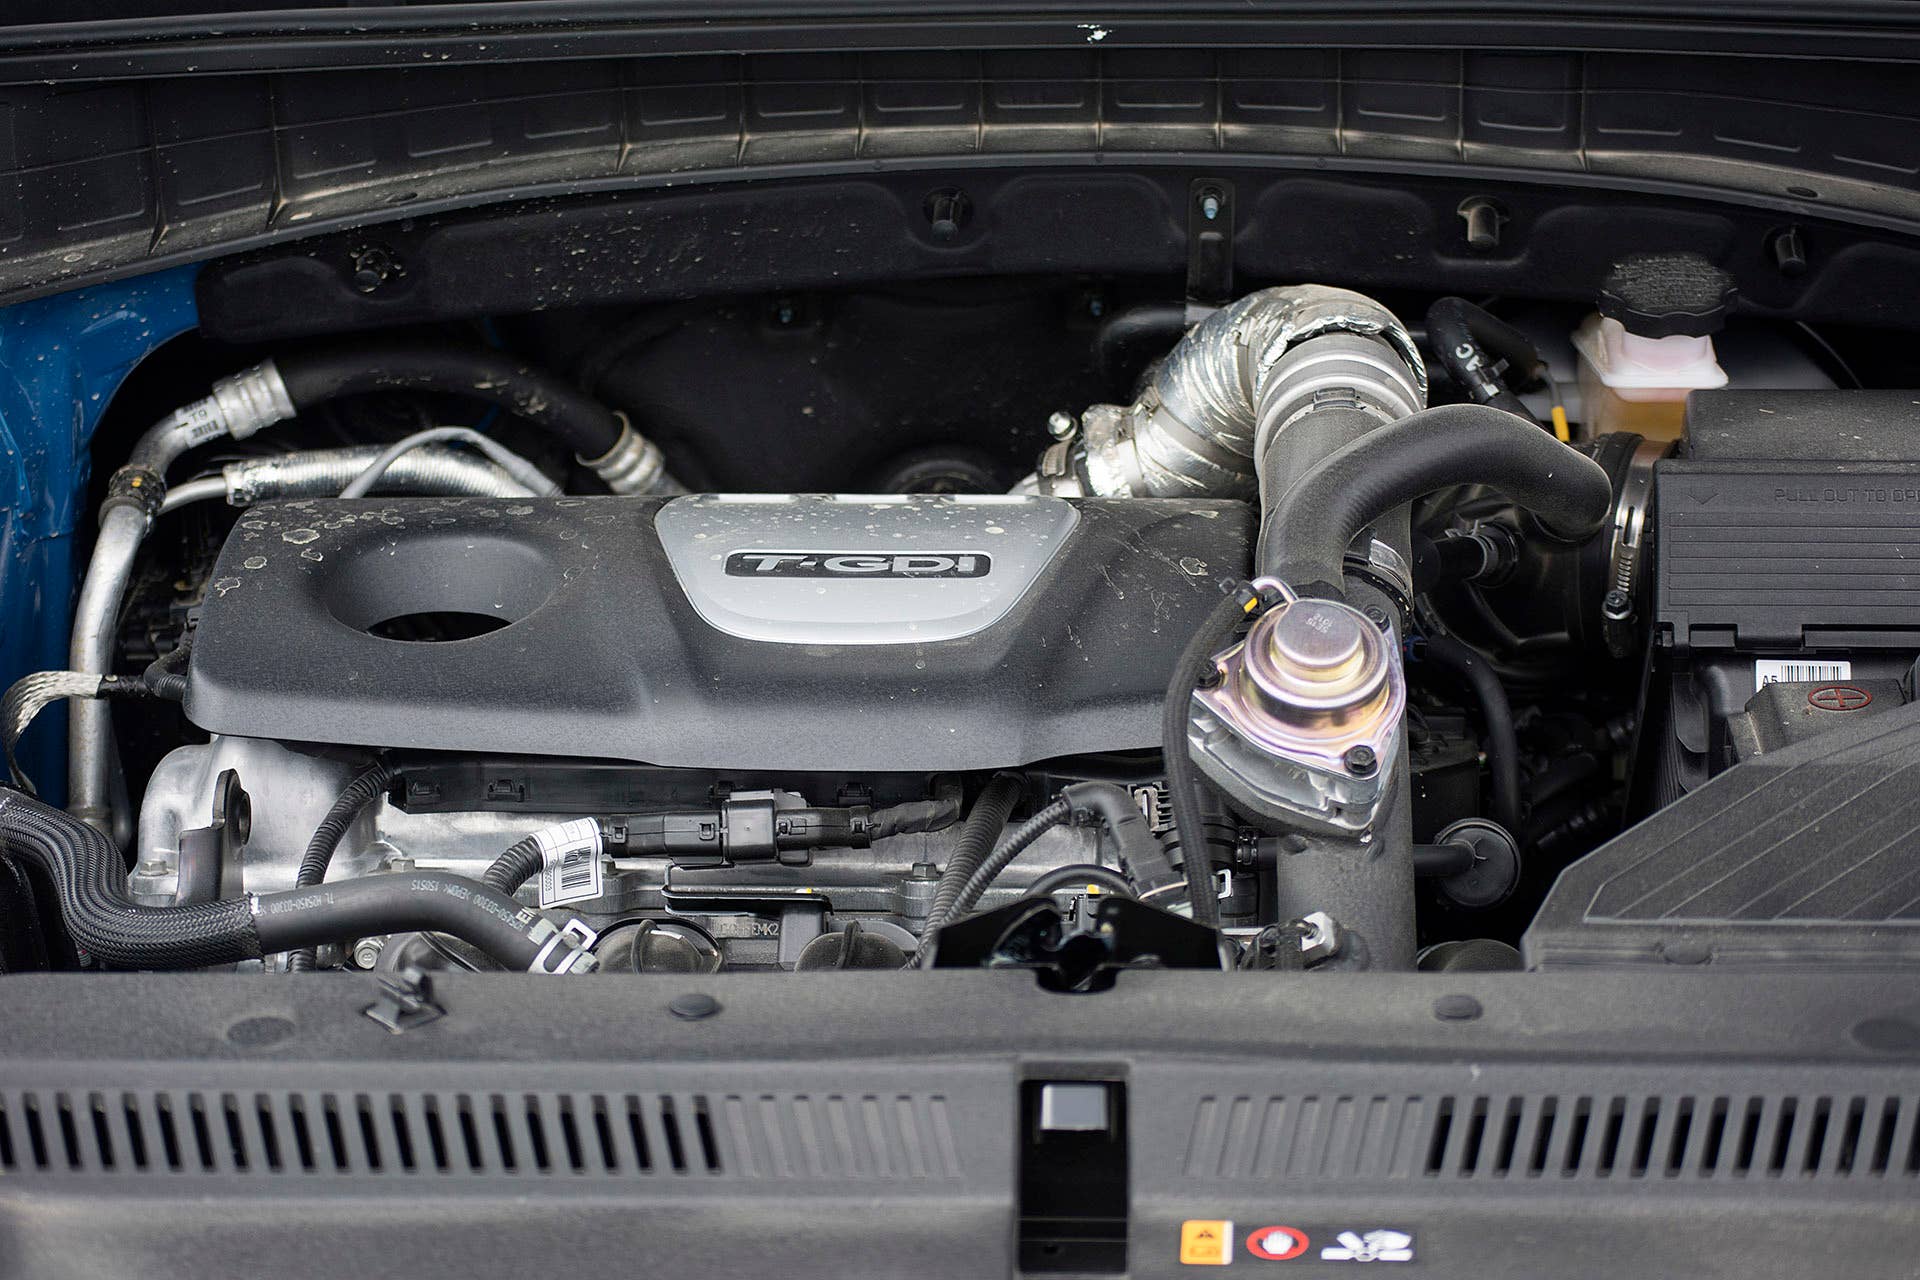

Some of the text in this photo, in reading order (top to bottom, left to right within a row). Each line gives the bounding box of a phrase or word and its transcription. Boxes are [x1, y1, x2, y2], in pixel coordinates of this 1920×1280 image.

[1774, 488, 1819, 502] PULL
[1823, 488, 1859, 502] OUT
[1864, 488, 1886, 502] TO
[743, 554, 976, 573] T-GDI
